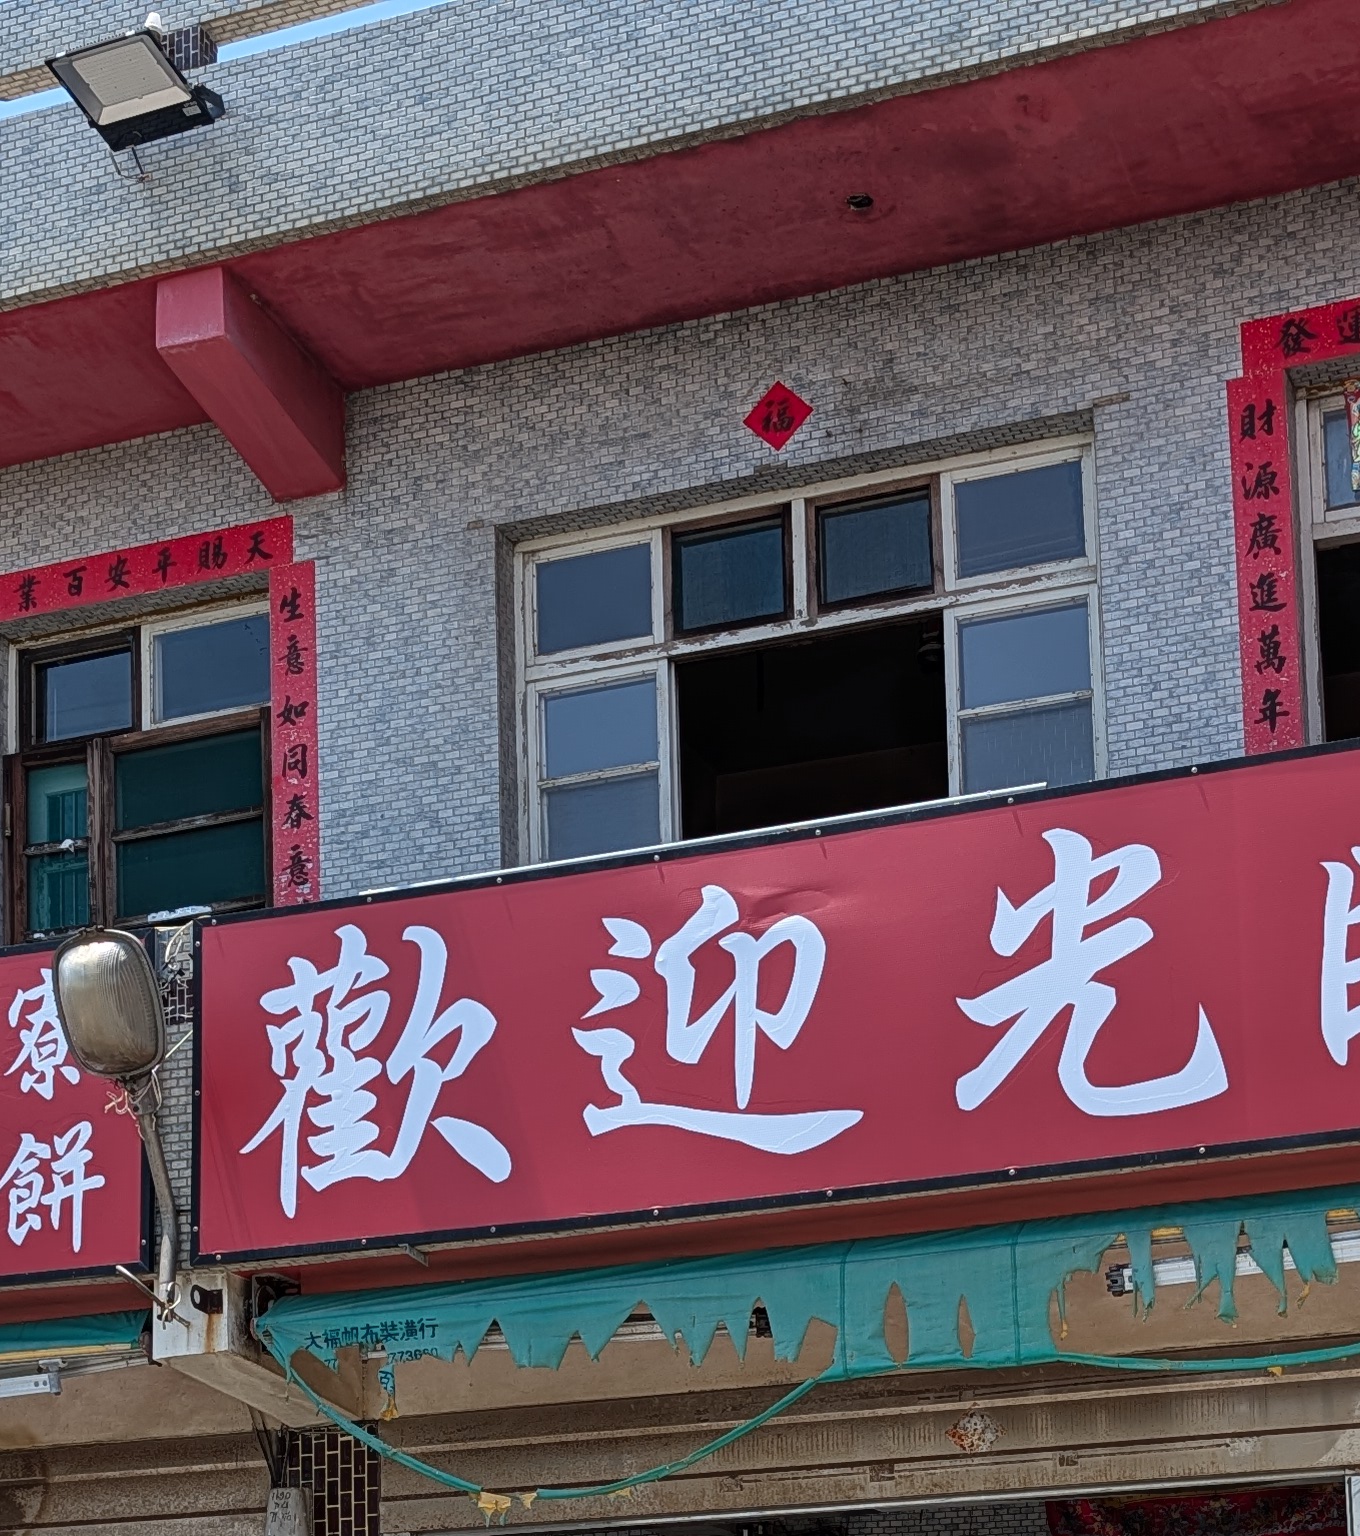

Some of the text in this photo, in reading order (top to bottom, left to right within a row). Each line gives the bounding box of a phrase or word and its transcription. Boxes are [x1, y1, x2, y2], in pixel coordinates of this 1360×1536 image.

[761, 397, 794, 434] 福
[1240, 398, 1290, 733] 財源廣進萬年
[277, 587, 314, 904] 生意如同春意
